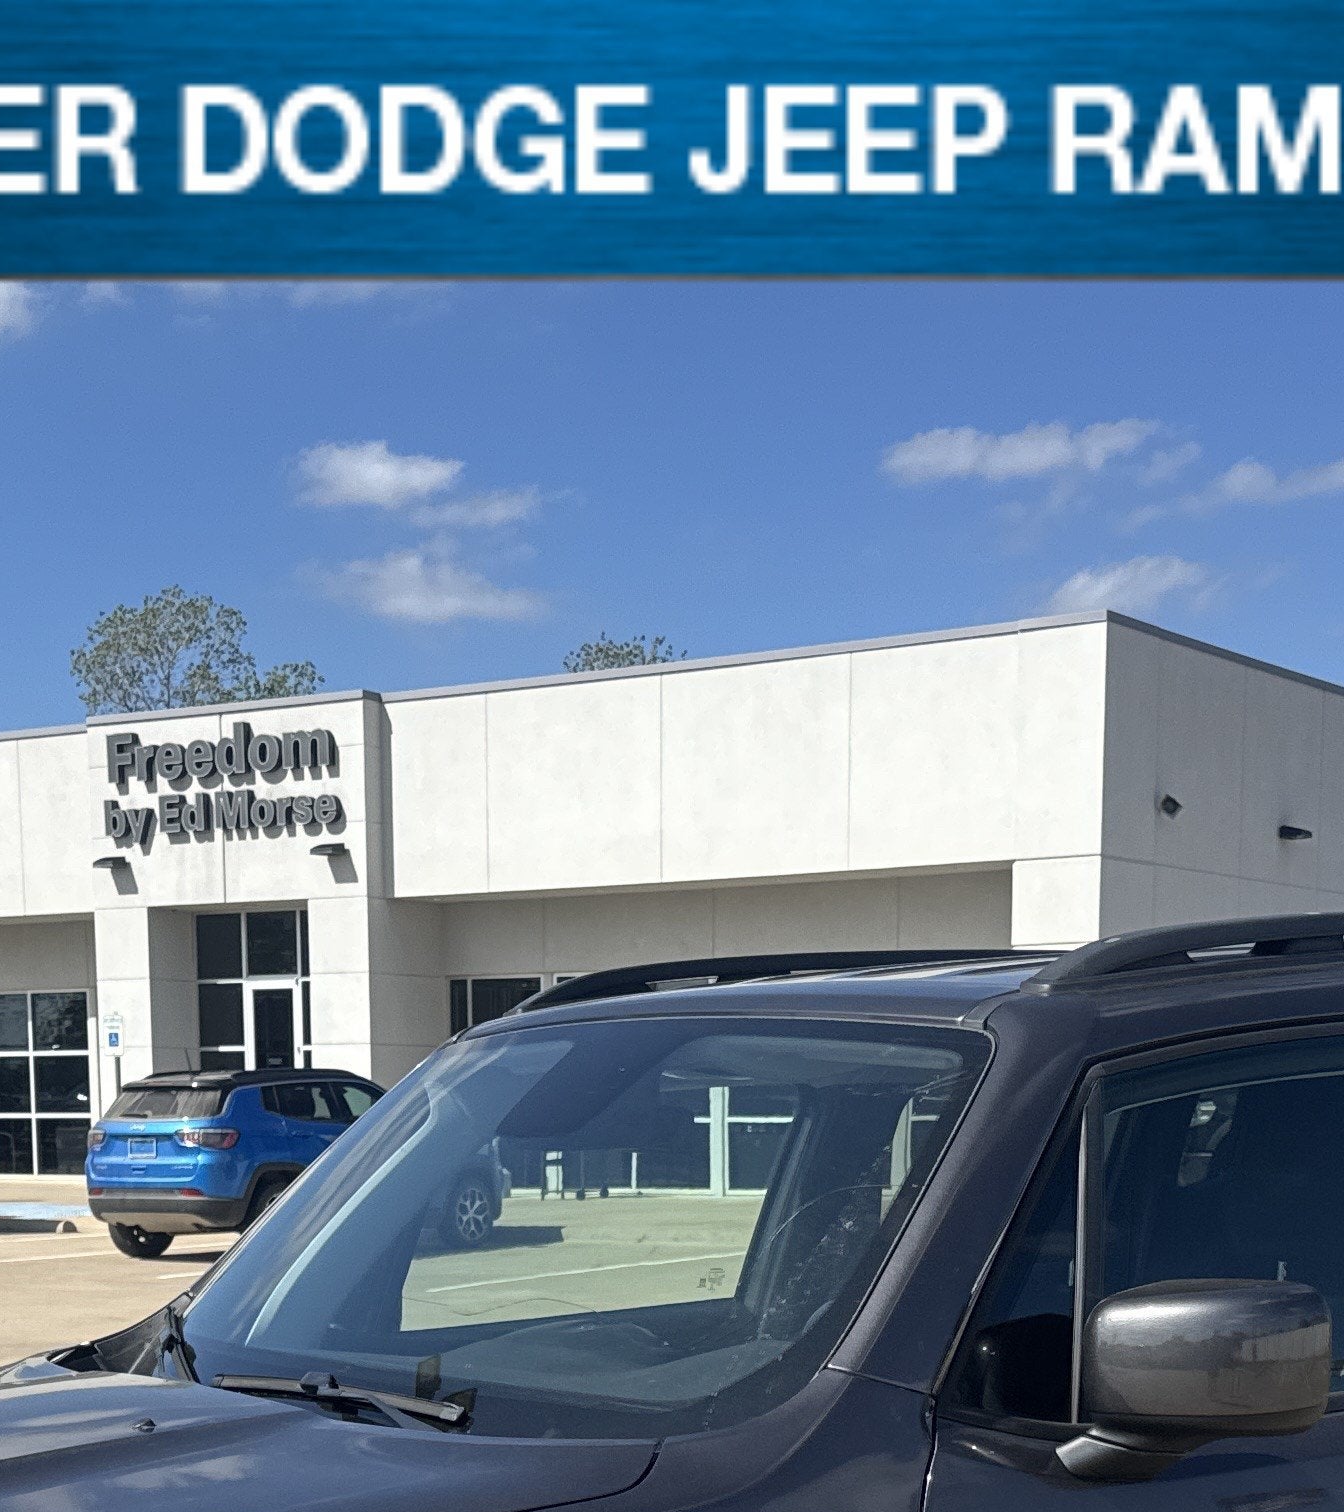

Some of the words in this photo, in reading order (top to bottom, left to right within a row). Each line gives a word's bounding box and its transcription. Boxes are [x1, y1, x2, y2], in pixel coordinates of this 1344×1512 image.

[106, 722, 339, 783] Freedom
[104, 800, 154, 849] by
[159, 792, 211, 833] Ed
[214, 790, 344, 830] Morse
